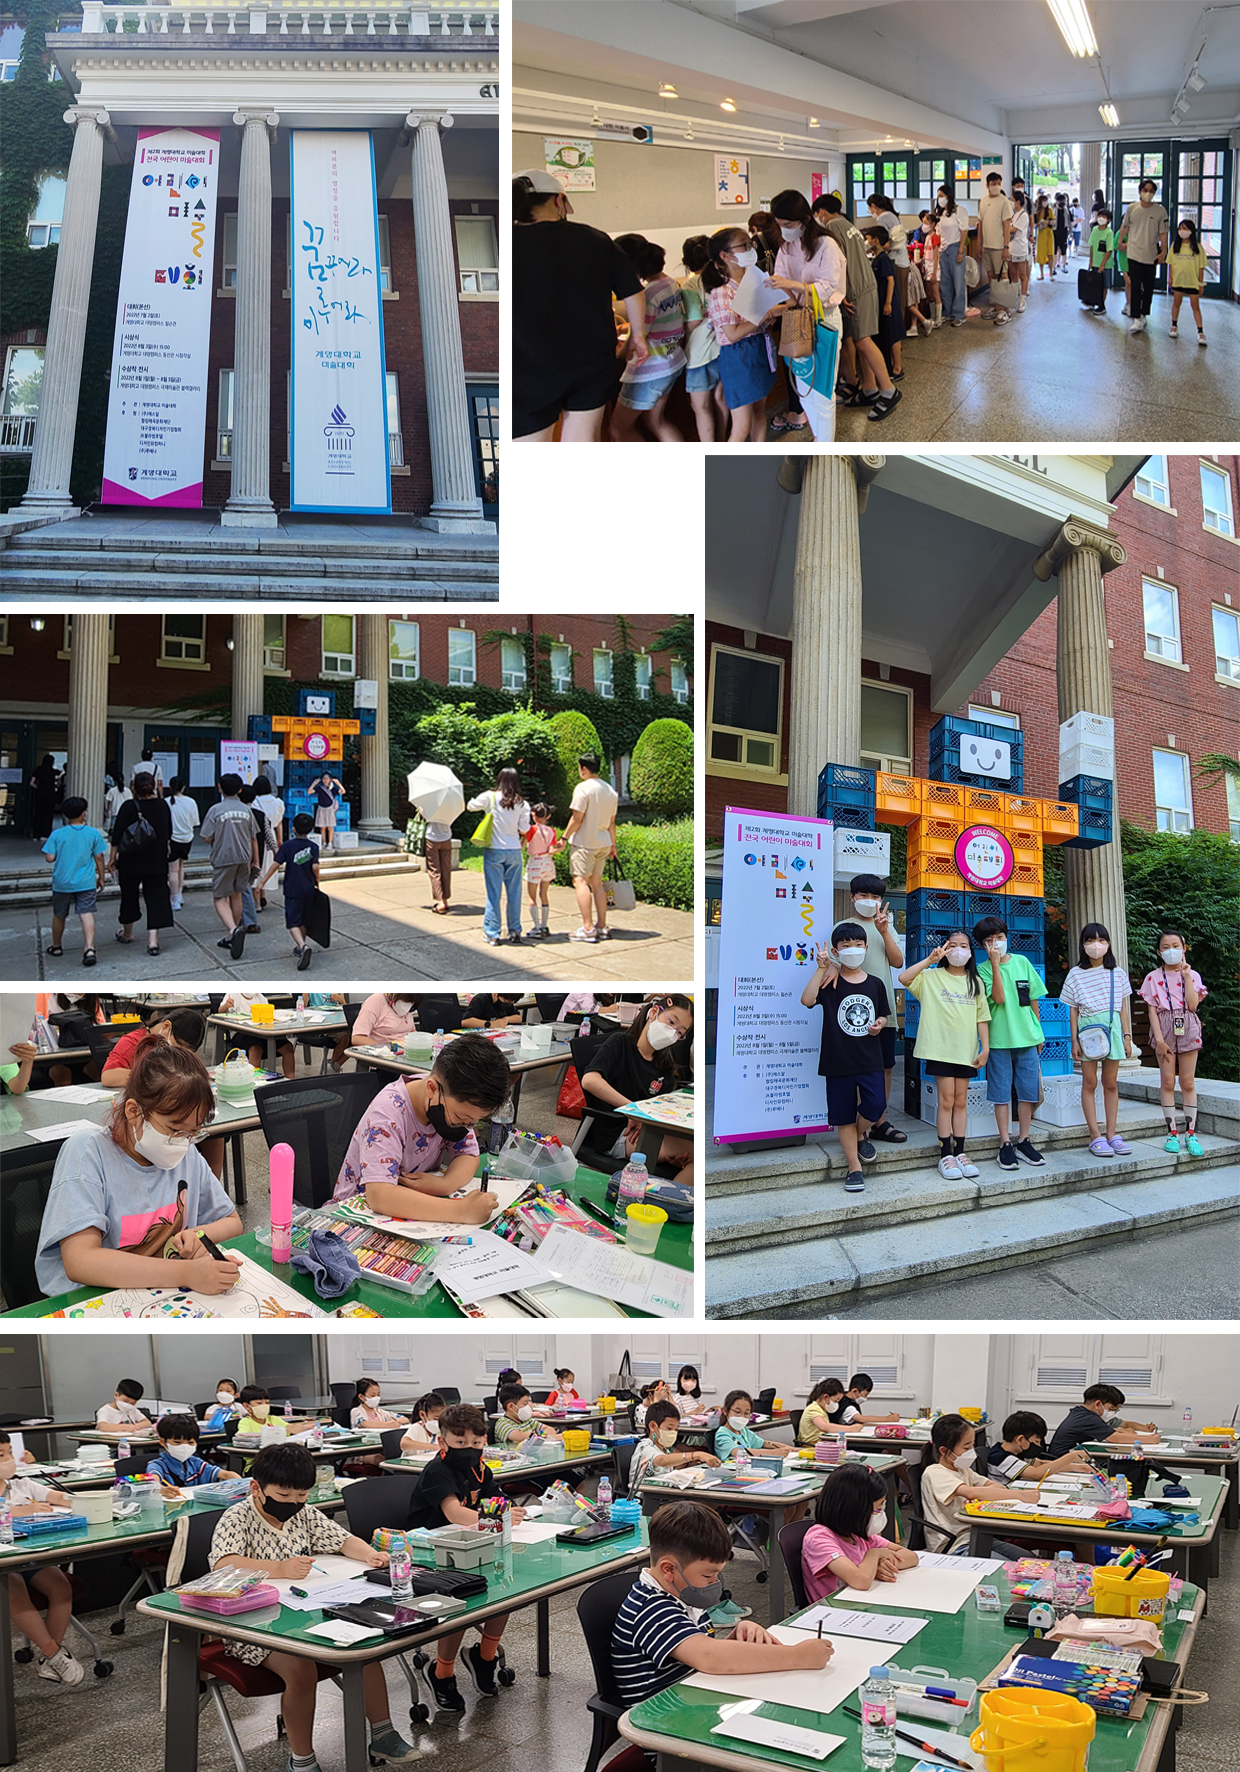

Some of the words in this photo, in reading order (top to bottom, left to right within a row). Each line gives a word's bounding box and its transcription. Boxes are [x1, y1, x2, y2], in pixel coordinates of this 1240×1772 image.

[180, 156, 205, 164] 미술대회
[315, 350, 361, 359] 계명대학교
[121, 365, 138, 373] 수상작
[321, 361, 355, 369] 미술대학
[141, 469, 177, 477] 계명대학교
[762, 828, 790, 836] 계명대학교
[792, 831, 813, 839] 미술대학
[971, 829, 999, 840] WELCOME
[744, 834, 759, 842] 전국
[761, 835, 783, 844] 어린이
[785, 838, 812, 847] 미술대회
[842, 998, 872, 1011] DODGERS
[842, 1020, 851, 1030] LOS
[1026, 1670, 1056, 1681] Pastel
